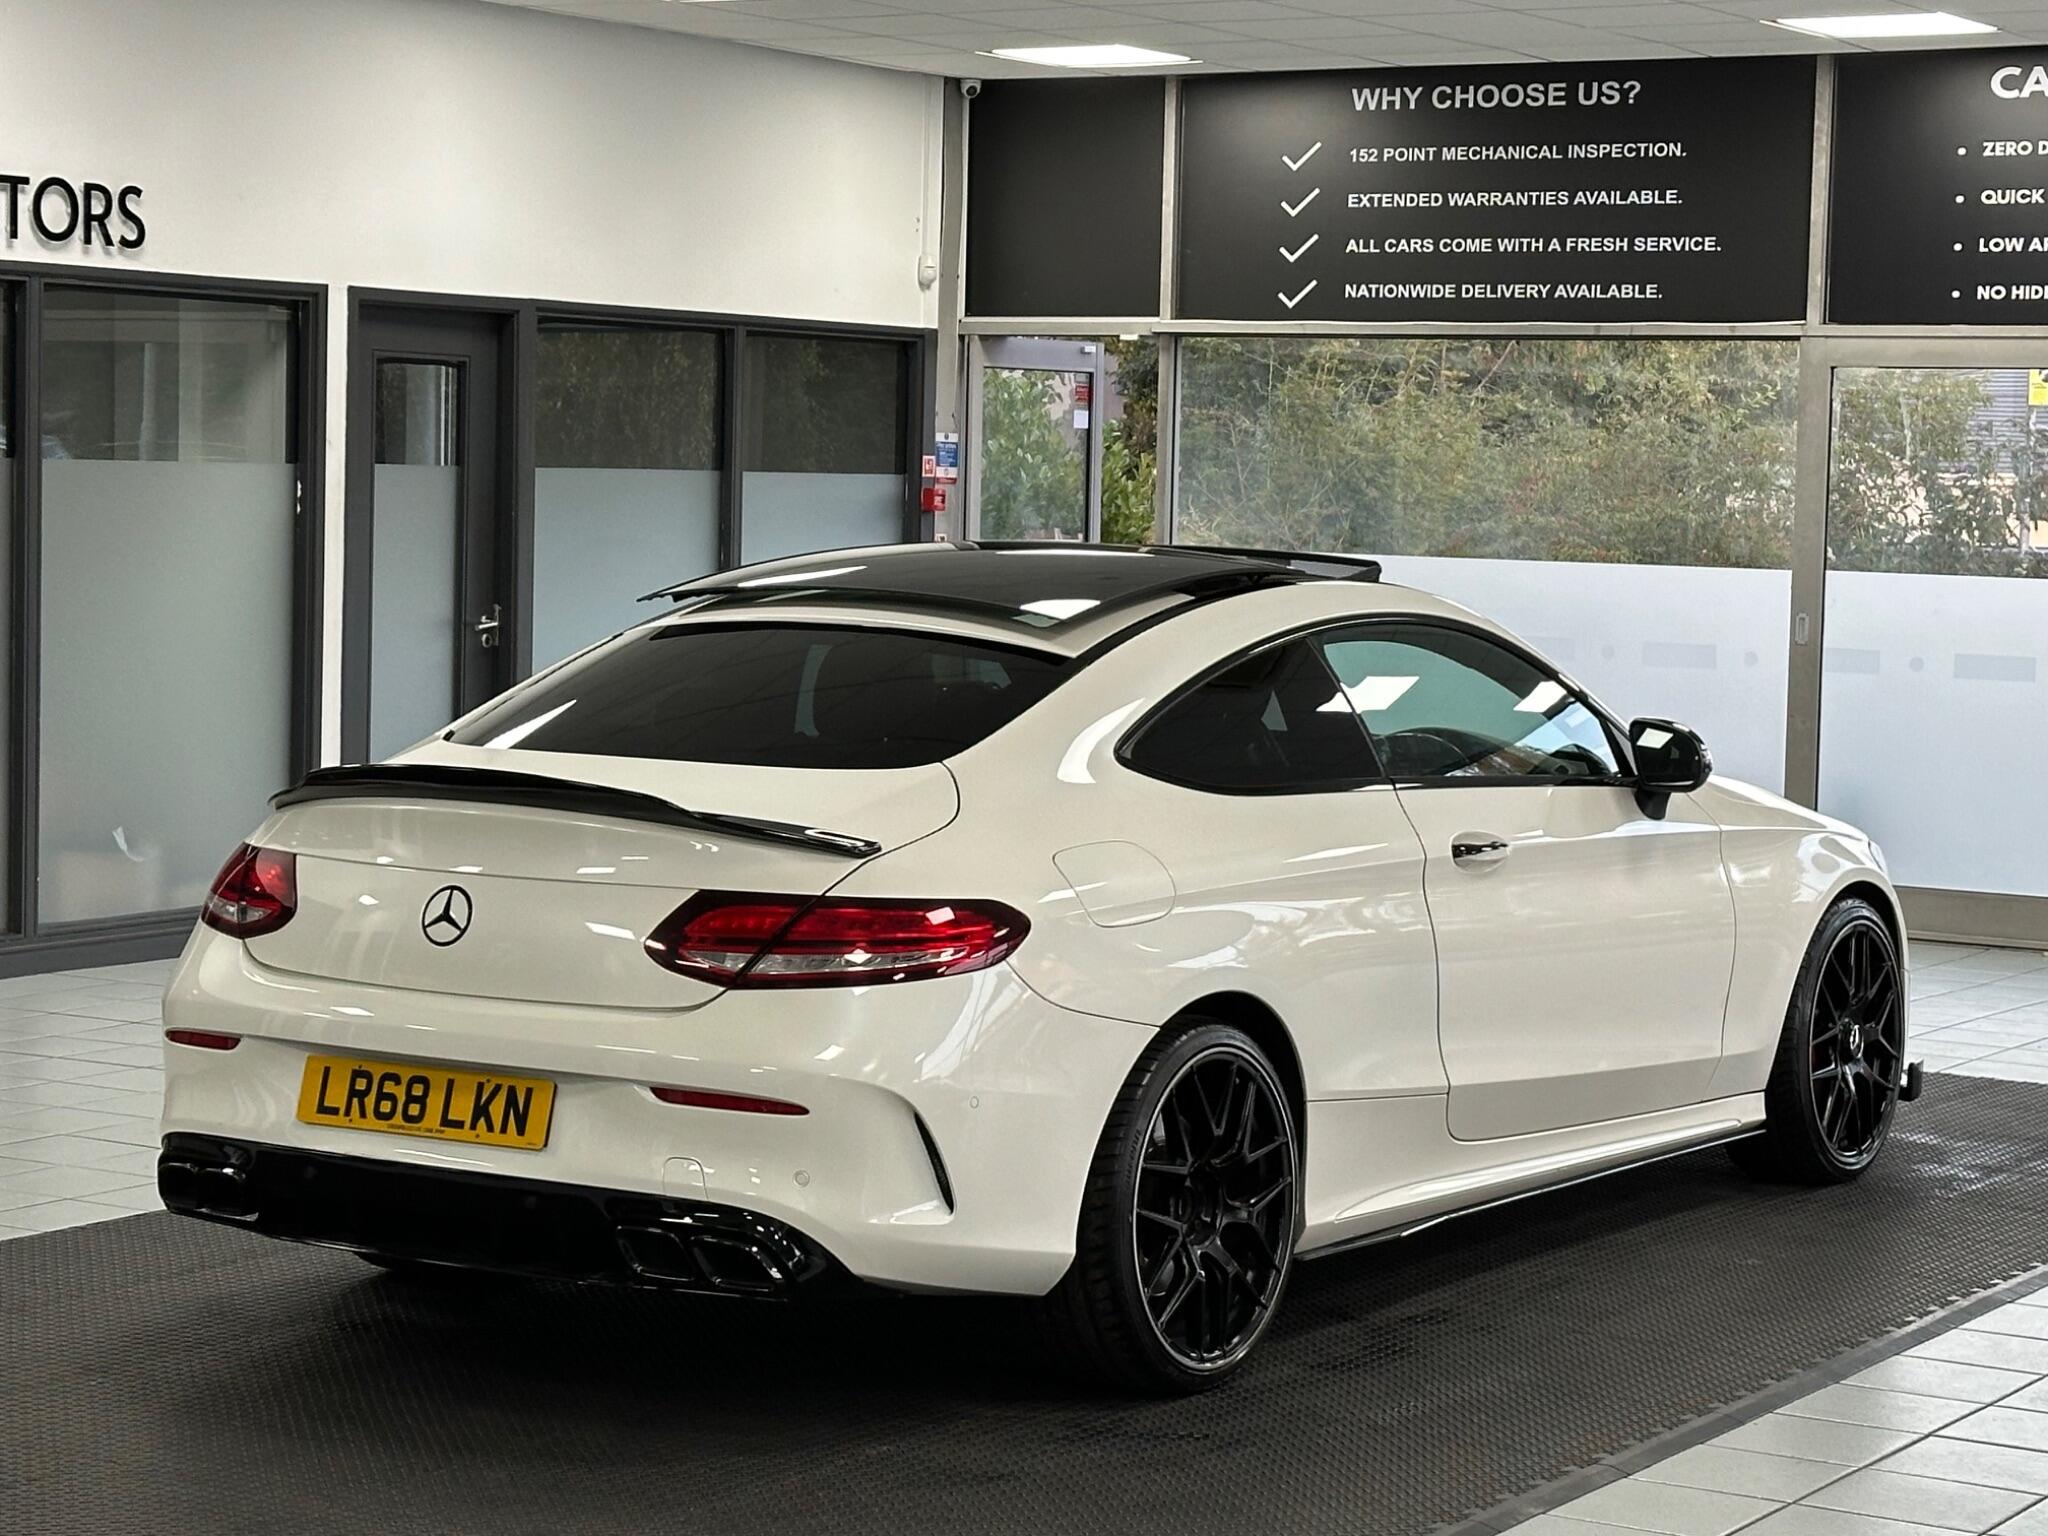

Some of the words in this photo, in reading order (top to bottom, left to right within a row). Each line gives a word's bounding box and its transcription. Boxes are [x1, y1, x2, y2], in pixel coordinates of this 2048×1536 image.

[1351, 87, 1424, 112] WHY
[1431, 83, 1567, 110] CHOOSE
[1578, 81, 1642, 106] US?
[1349, 148, 1379, 163] 152
[1382, 147, 1438, 162] POINT
[1441, 144, 1564, 161] MECHANICAL
[1567, 142, 1687, 159] INSPECTION.
[1982, 140, 2034, 157] ZERO
[1347, 193, 1444, 209] EXTENDED
[1447, 191, 1569, 207] WARRANTIES
[1573, 189, 1683, 206] AVAILABLE.
[1980, 188, 2046, 205] QUICK
[0, 174, 146, 249] TORS
[1345, 238, 1380, 254] ALL
[1384, 238, 1435, 254] CARS
[1438, 237, 1493, 253] COME
[1496, 237, 1544, 253] WITH
[1547, 237, 1562, 253] A
[1565, 237, 1629, 253] FRESH
[1633, 236, 1722, 252] SERVICE.
[1978, 237, 2025, 253] LOW
[1344, 283, 1457, 299] NATIONWIDE
[1461, 283, 1552, 299] DELIVERY
[1553, 283, 1663, 299] AVAILABLE.
[1976, 284, 2007, 301] NO
[316, 1066, 430, 1125] LR68
[439, 1078, 533, 1137] LKN
